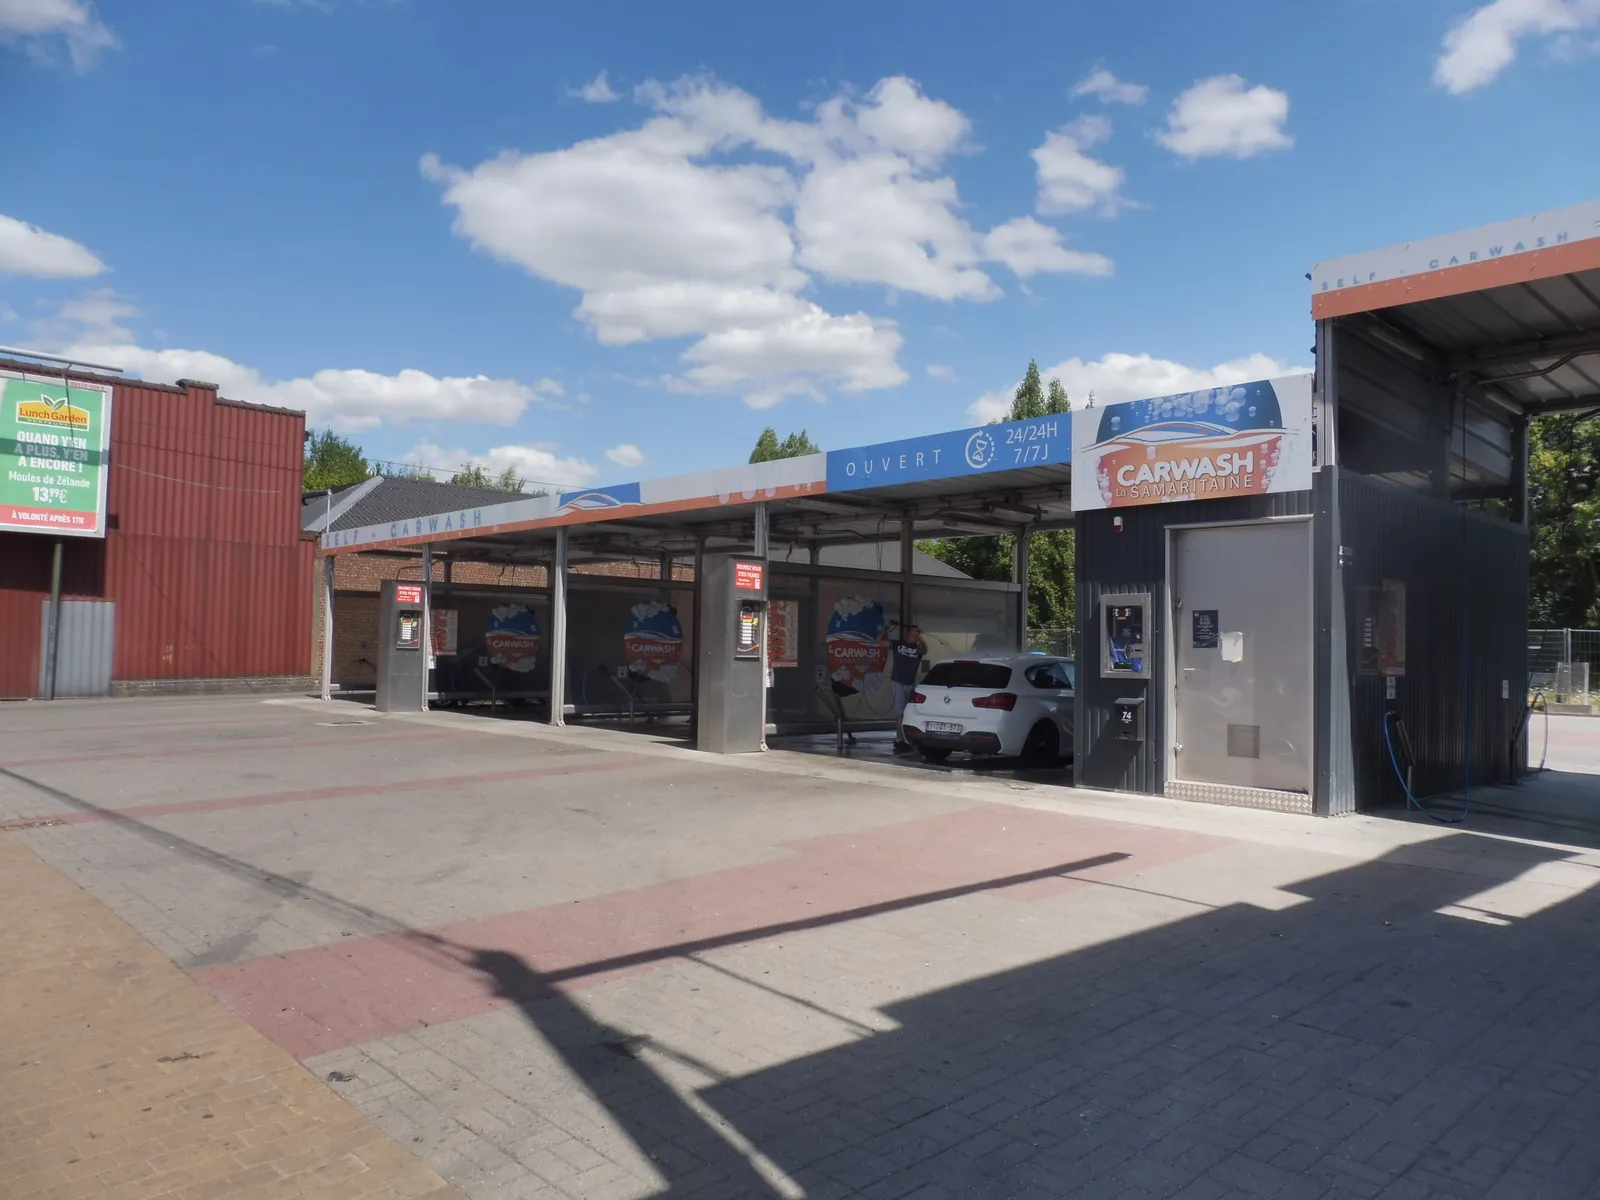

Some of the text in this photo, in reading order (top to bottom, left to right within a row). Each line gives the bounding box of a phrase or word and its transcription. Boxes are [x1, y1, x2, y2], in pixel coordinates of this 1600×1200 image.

[1321, 272, 1376, 291] SELF
[1429, 231, 1569, 270] CARWASH
[19, 407, 87, 425] Lunch Garden
[17, 431, 86, 449] QUAND Y'EN
[1005, 421, 1058, 445] 24/24H
[14, 443, 23, 454] A
[63, 450, 88, 462] Y'EN
[1013, 444, 1049, 465] 7/7J
[18, 456, 27, 467] A
[30, 457, 76, 472] ENCORE
[846, 449, 942, 477] OUVERT
[1117, 450, 1254, 487] CARWASH
[8, 470, 90, 488] Moules de Zélande
[1116, 474, 1253, 499] La SAMARITAINE
[18, 511, 49, 522] VOLONTÉ
[49, 513, 71, 524] APRÈS
[325, 530, 358, 548] SELF
[390, 509, 482, 538] CARWASH
[492, 640, 534, 648] CARWASH
[631, 643, 676, 653] CARWASH
[834, 647, 880, 658] CARWASH
[1122, 711, 1132, 719] 74
